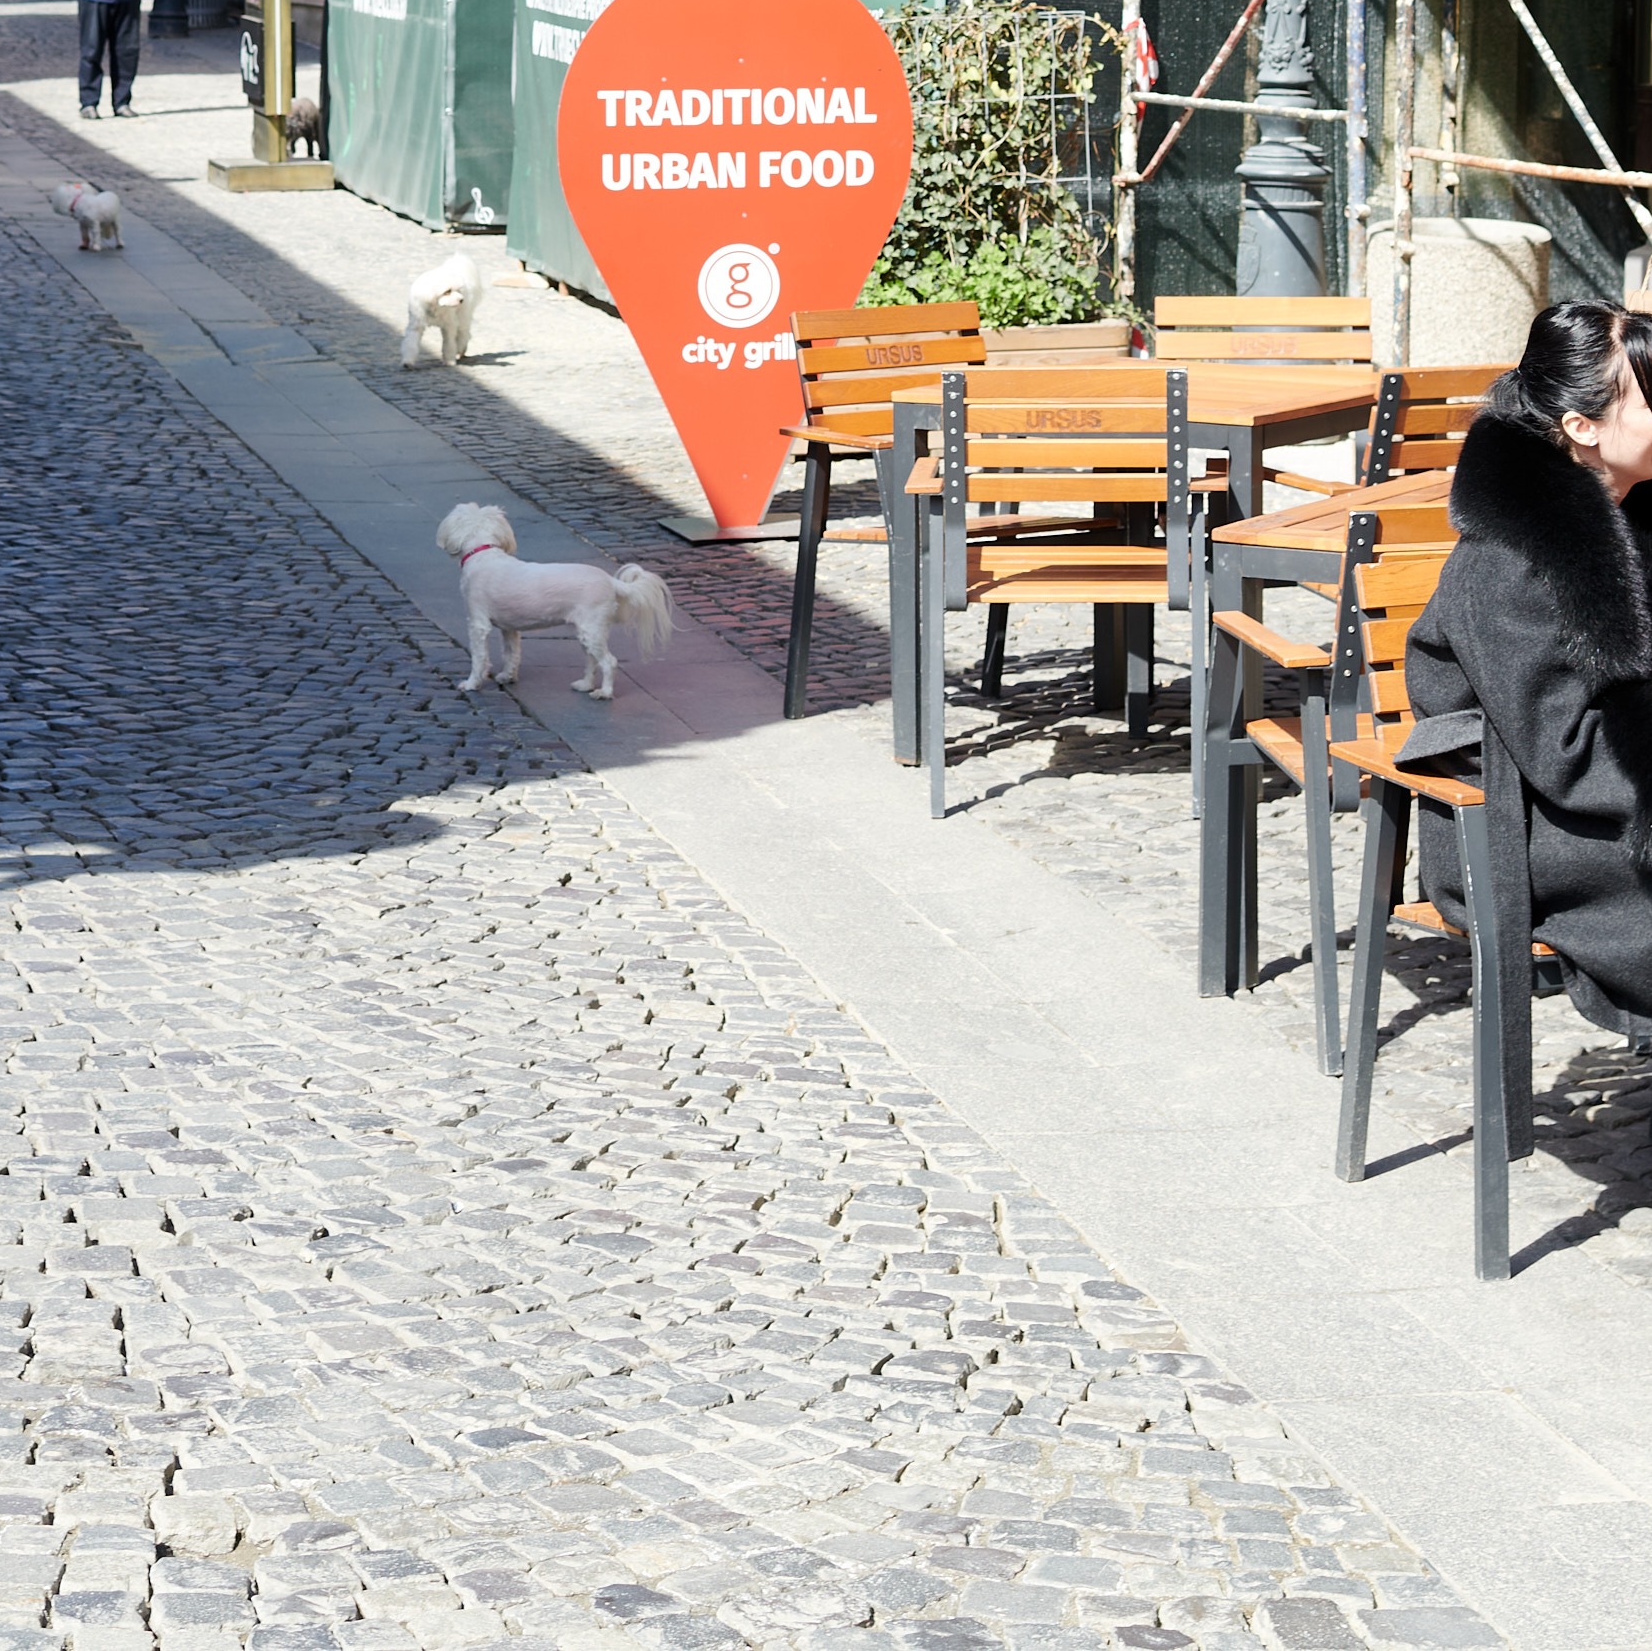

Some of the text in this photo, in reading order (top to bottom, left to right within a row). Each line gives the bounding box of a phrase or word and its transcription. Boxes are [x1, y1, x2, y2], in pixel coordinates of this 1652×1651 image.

[597, 87, 877, 127] TRADITIONAL
[602, 150, 874, 191] URBAN FOOD
[682, 335, 736, 370] city
[866, 345, 924, 365] URSUS
[1026, 408, 1103, 430] URSUS
